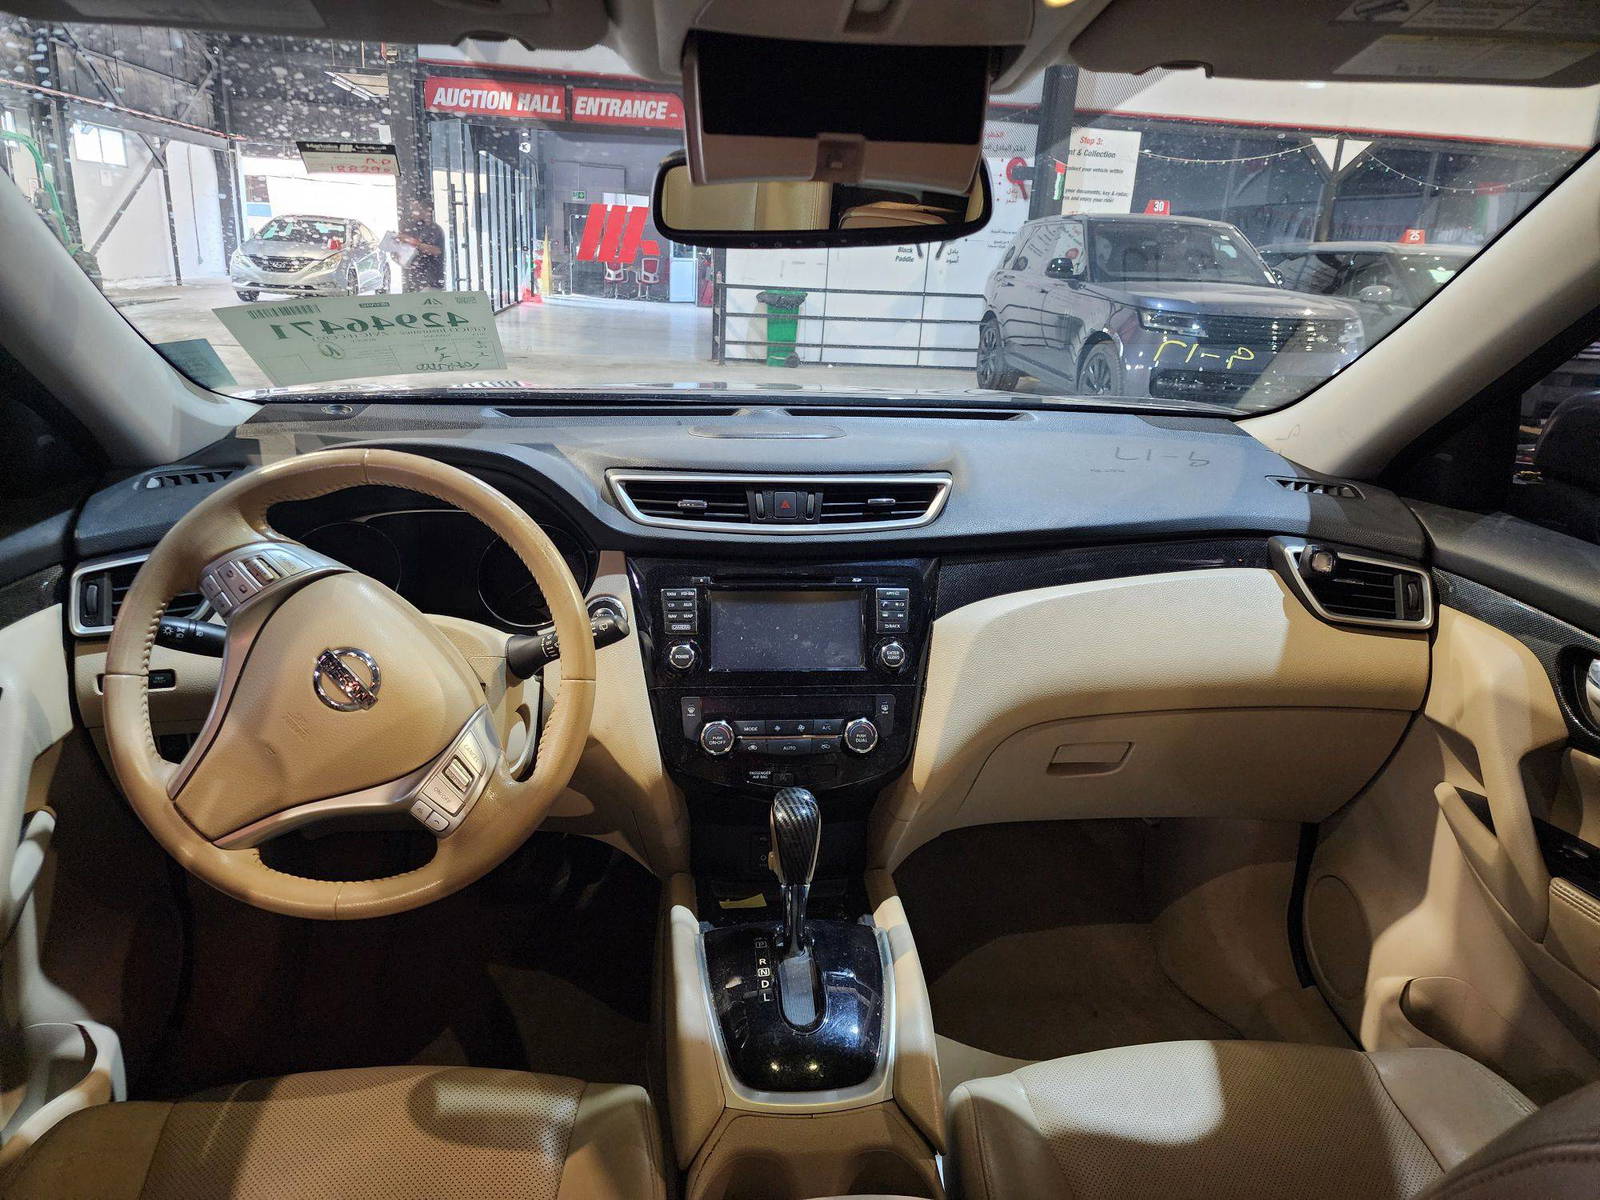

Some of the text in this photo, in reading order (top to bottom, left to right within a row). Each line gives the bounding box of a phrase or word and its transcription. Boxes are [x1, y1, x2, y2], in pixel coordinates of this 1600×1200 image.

[432, 87, 669, 121] AUCTION HALL ENTRANCE
[1079, 136, 1095, 146] Step
[1083, 149, 1117, 159] Collection
[1153, 200, 1165, 212] 30
[897, 246, 914, 254] Black
[895, 255, 915, 263] Paddle
[759, 957, 767, 965] R
[760, 968, 768, 976] N
[761, 980, 770, 988] D
[763, 993, 770, 1002] L
